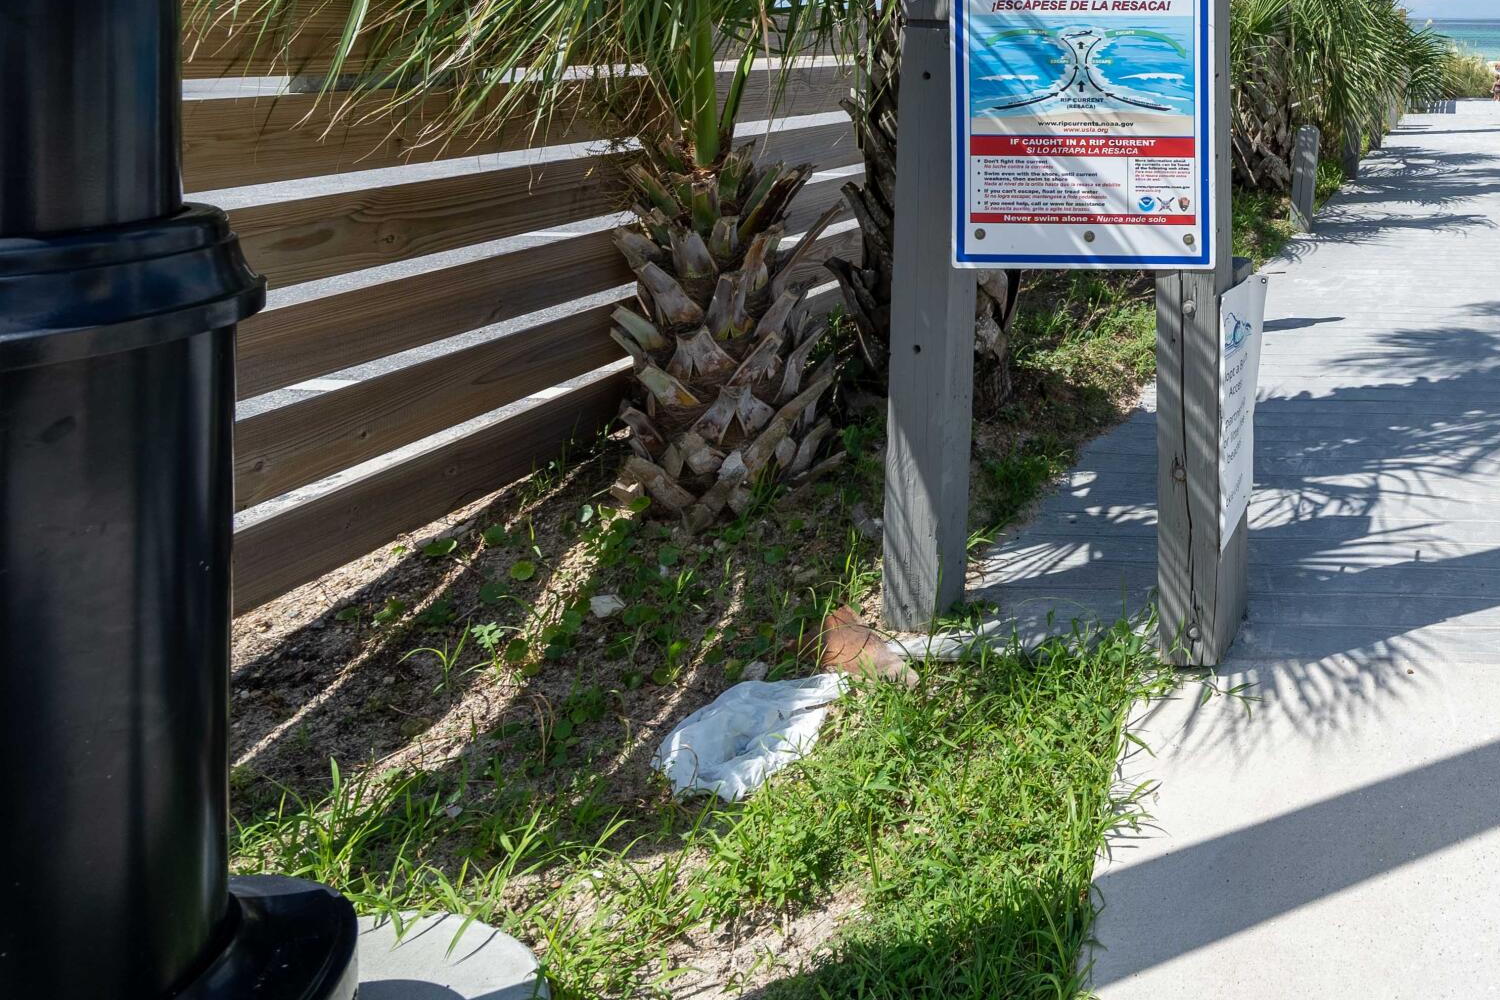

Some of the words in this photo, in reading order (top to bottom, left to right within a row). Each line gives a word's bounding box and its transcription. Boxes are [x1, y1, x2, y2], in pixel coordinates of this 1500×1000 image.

[1070, 1, 1088, 10] DE
[1092, 1, 1108, 10] LA
[1096, 215, 1124, 223] Nunca
[1125, 215, 1146, 223] nade
